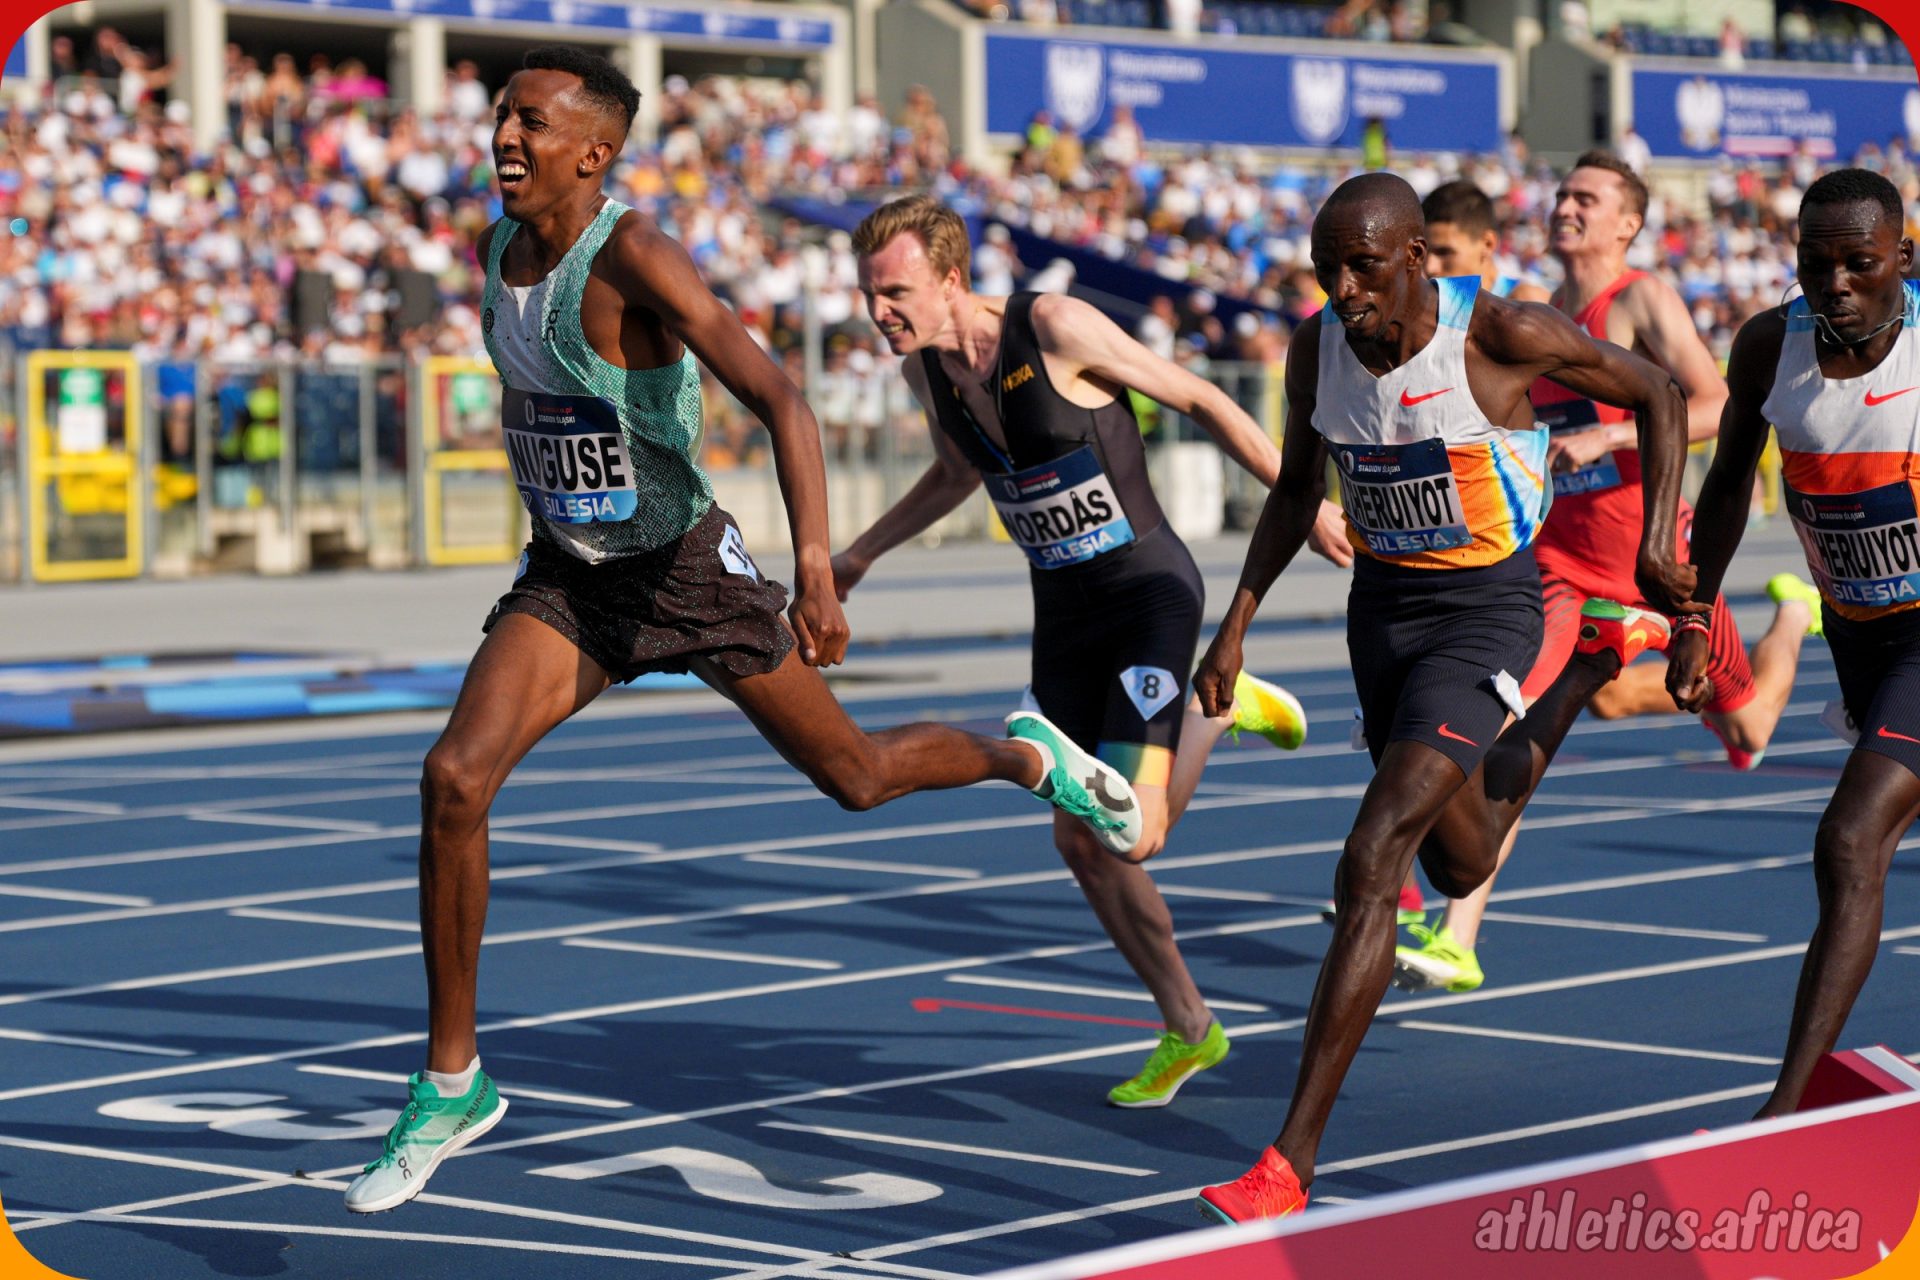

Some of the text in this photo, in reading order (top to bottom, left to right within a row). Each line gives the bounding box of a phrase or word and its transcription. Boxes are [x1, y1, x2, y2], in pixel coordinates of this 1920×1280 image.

[1003, 363, 1035, 392] HOKA
[508, 432, 626, 491] NUGUSE
[1358, 464, 1381, 473] STADION
[1554, 471, 1603, 495] ILESIA
[544, 496, 616, 517] SILESIA
[1041, 531, 1114, 563] SILESIA
[1367, 532, 1450, 552] SILESIA
[1832, 580, 1917, 601] SILESIA
[1142, 674, 1160, 699] 8
[452, 1075, 490, 1136] ON RUNNIN
